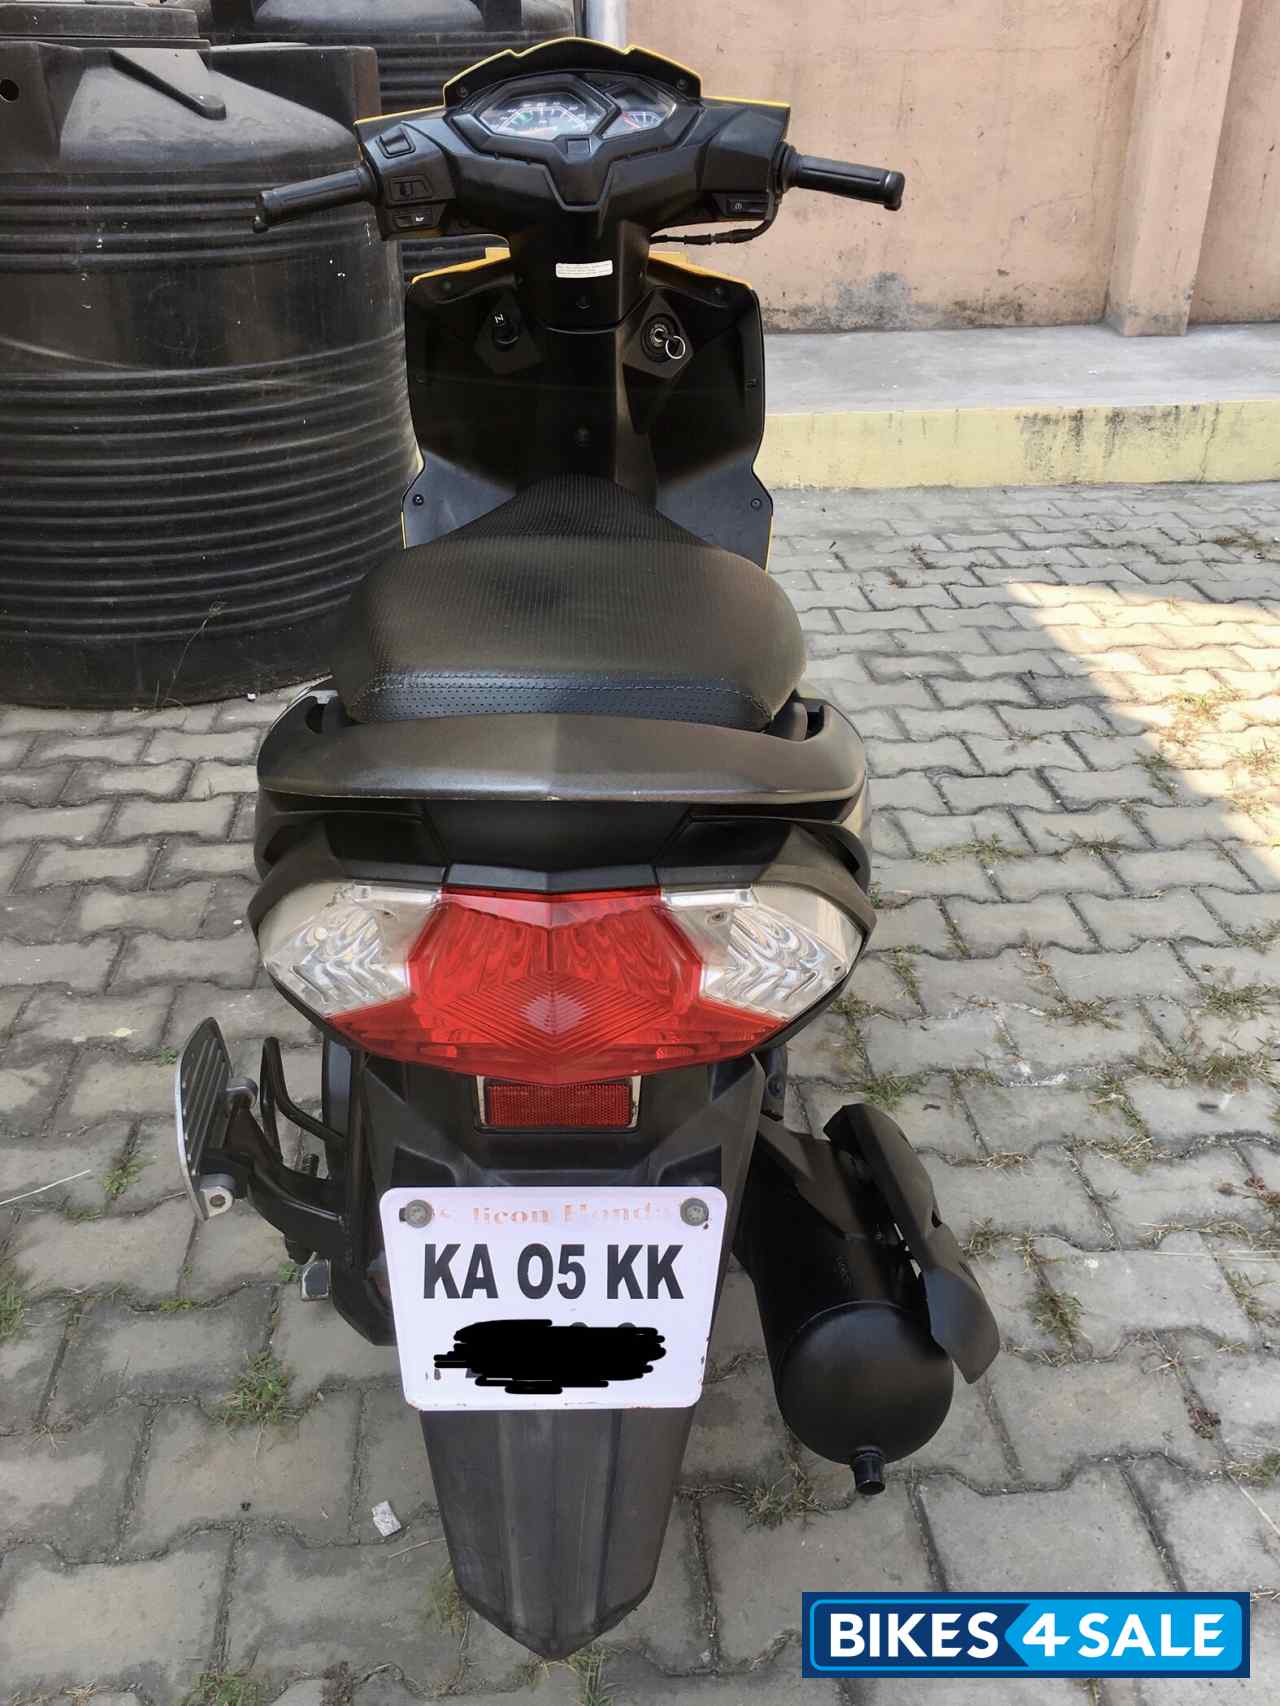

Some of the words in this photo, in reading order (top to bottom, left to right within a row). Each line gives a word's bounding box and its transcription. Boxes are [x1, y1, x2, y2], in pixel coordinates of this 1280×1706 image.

[423, 1243, 499, 1299] KA
[517, 1243, 586, 1300] 05
[606, 1244, 684, 1299] KK
